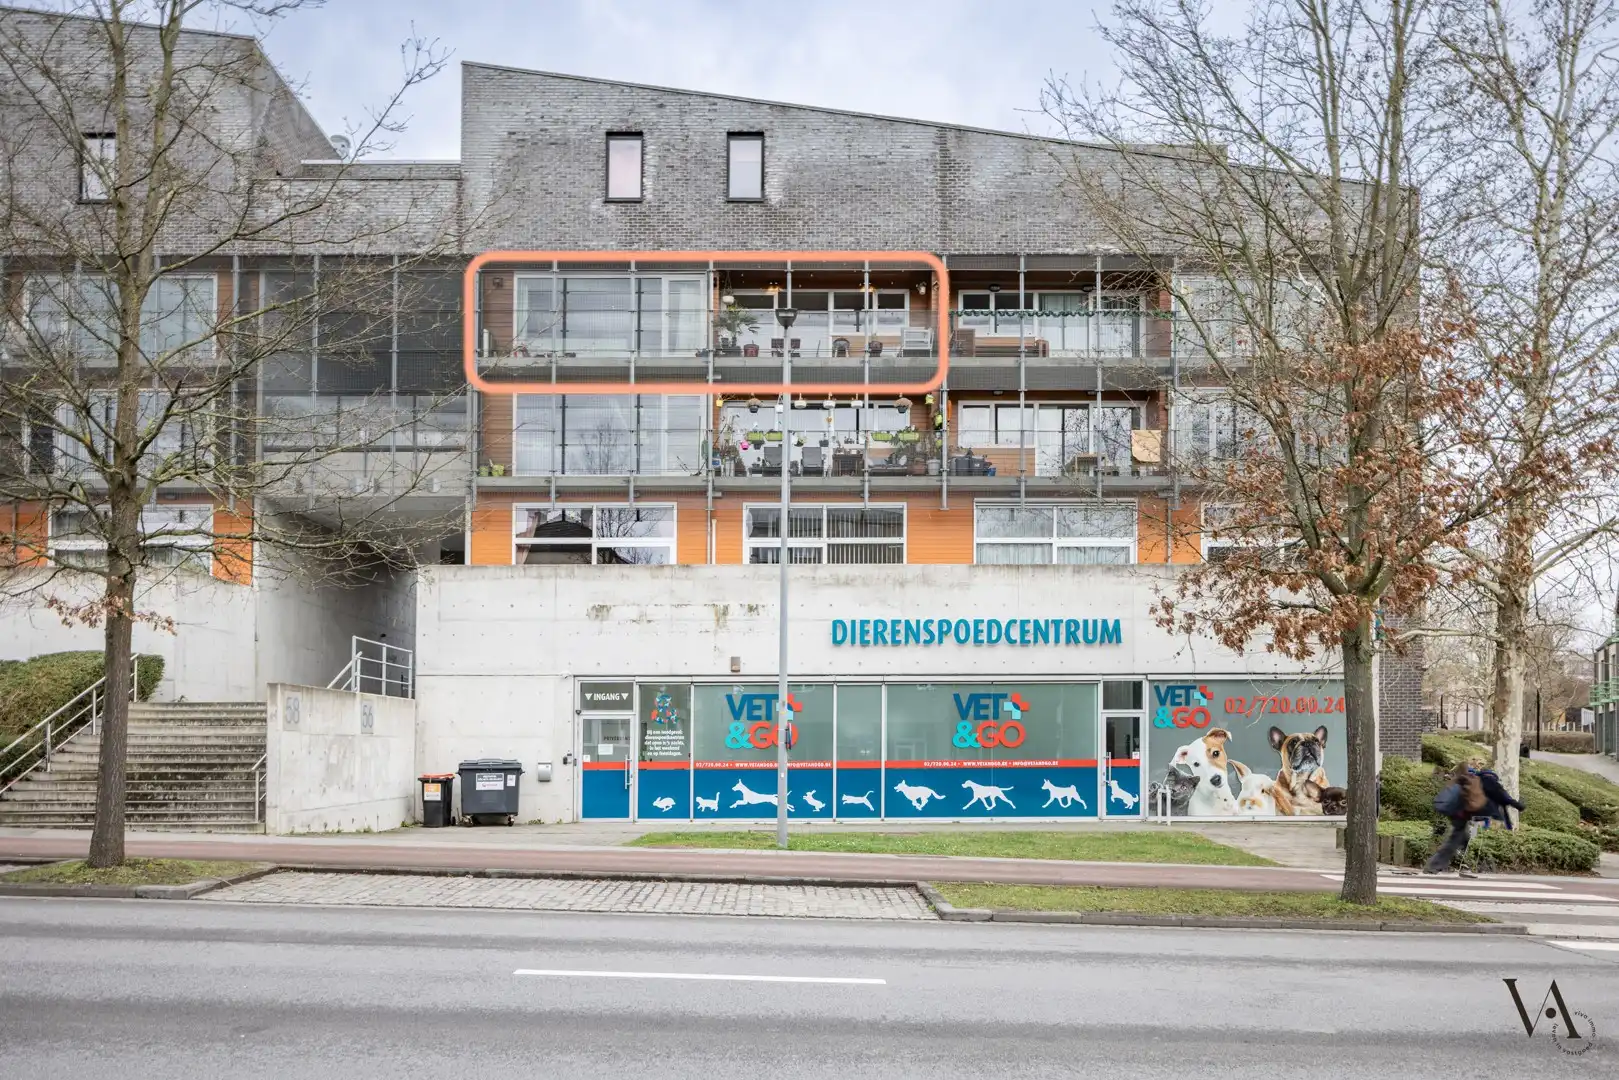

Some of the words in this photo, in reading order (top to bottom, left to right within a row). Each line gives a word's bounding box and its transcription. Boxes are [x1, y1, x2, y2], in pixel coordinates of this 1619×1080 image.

[832, 619, 1122, 645] DIERENSPOEDCENTRUM
[593, 693, 620, 701] INGANG
[726, 693, 779, 721] VET
[953, 693, 1008, 721] VET
[1154, 685, 1197, 706] VET
[1225, 696, 1344, 717] 02/720.00.24
[286, 697, 300, 724] 58
[363, 705, 374, 728] 56
[1153, 705, 1211, 729] &GO
[952, 720, 1026, 749] &GO
